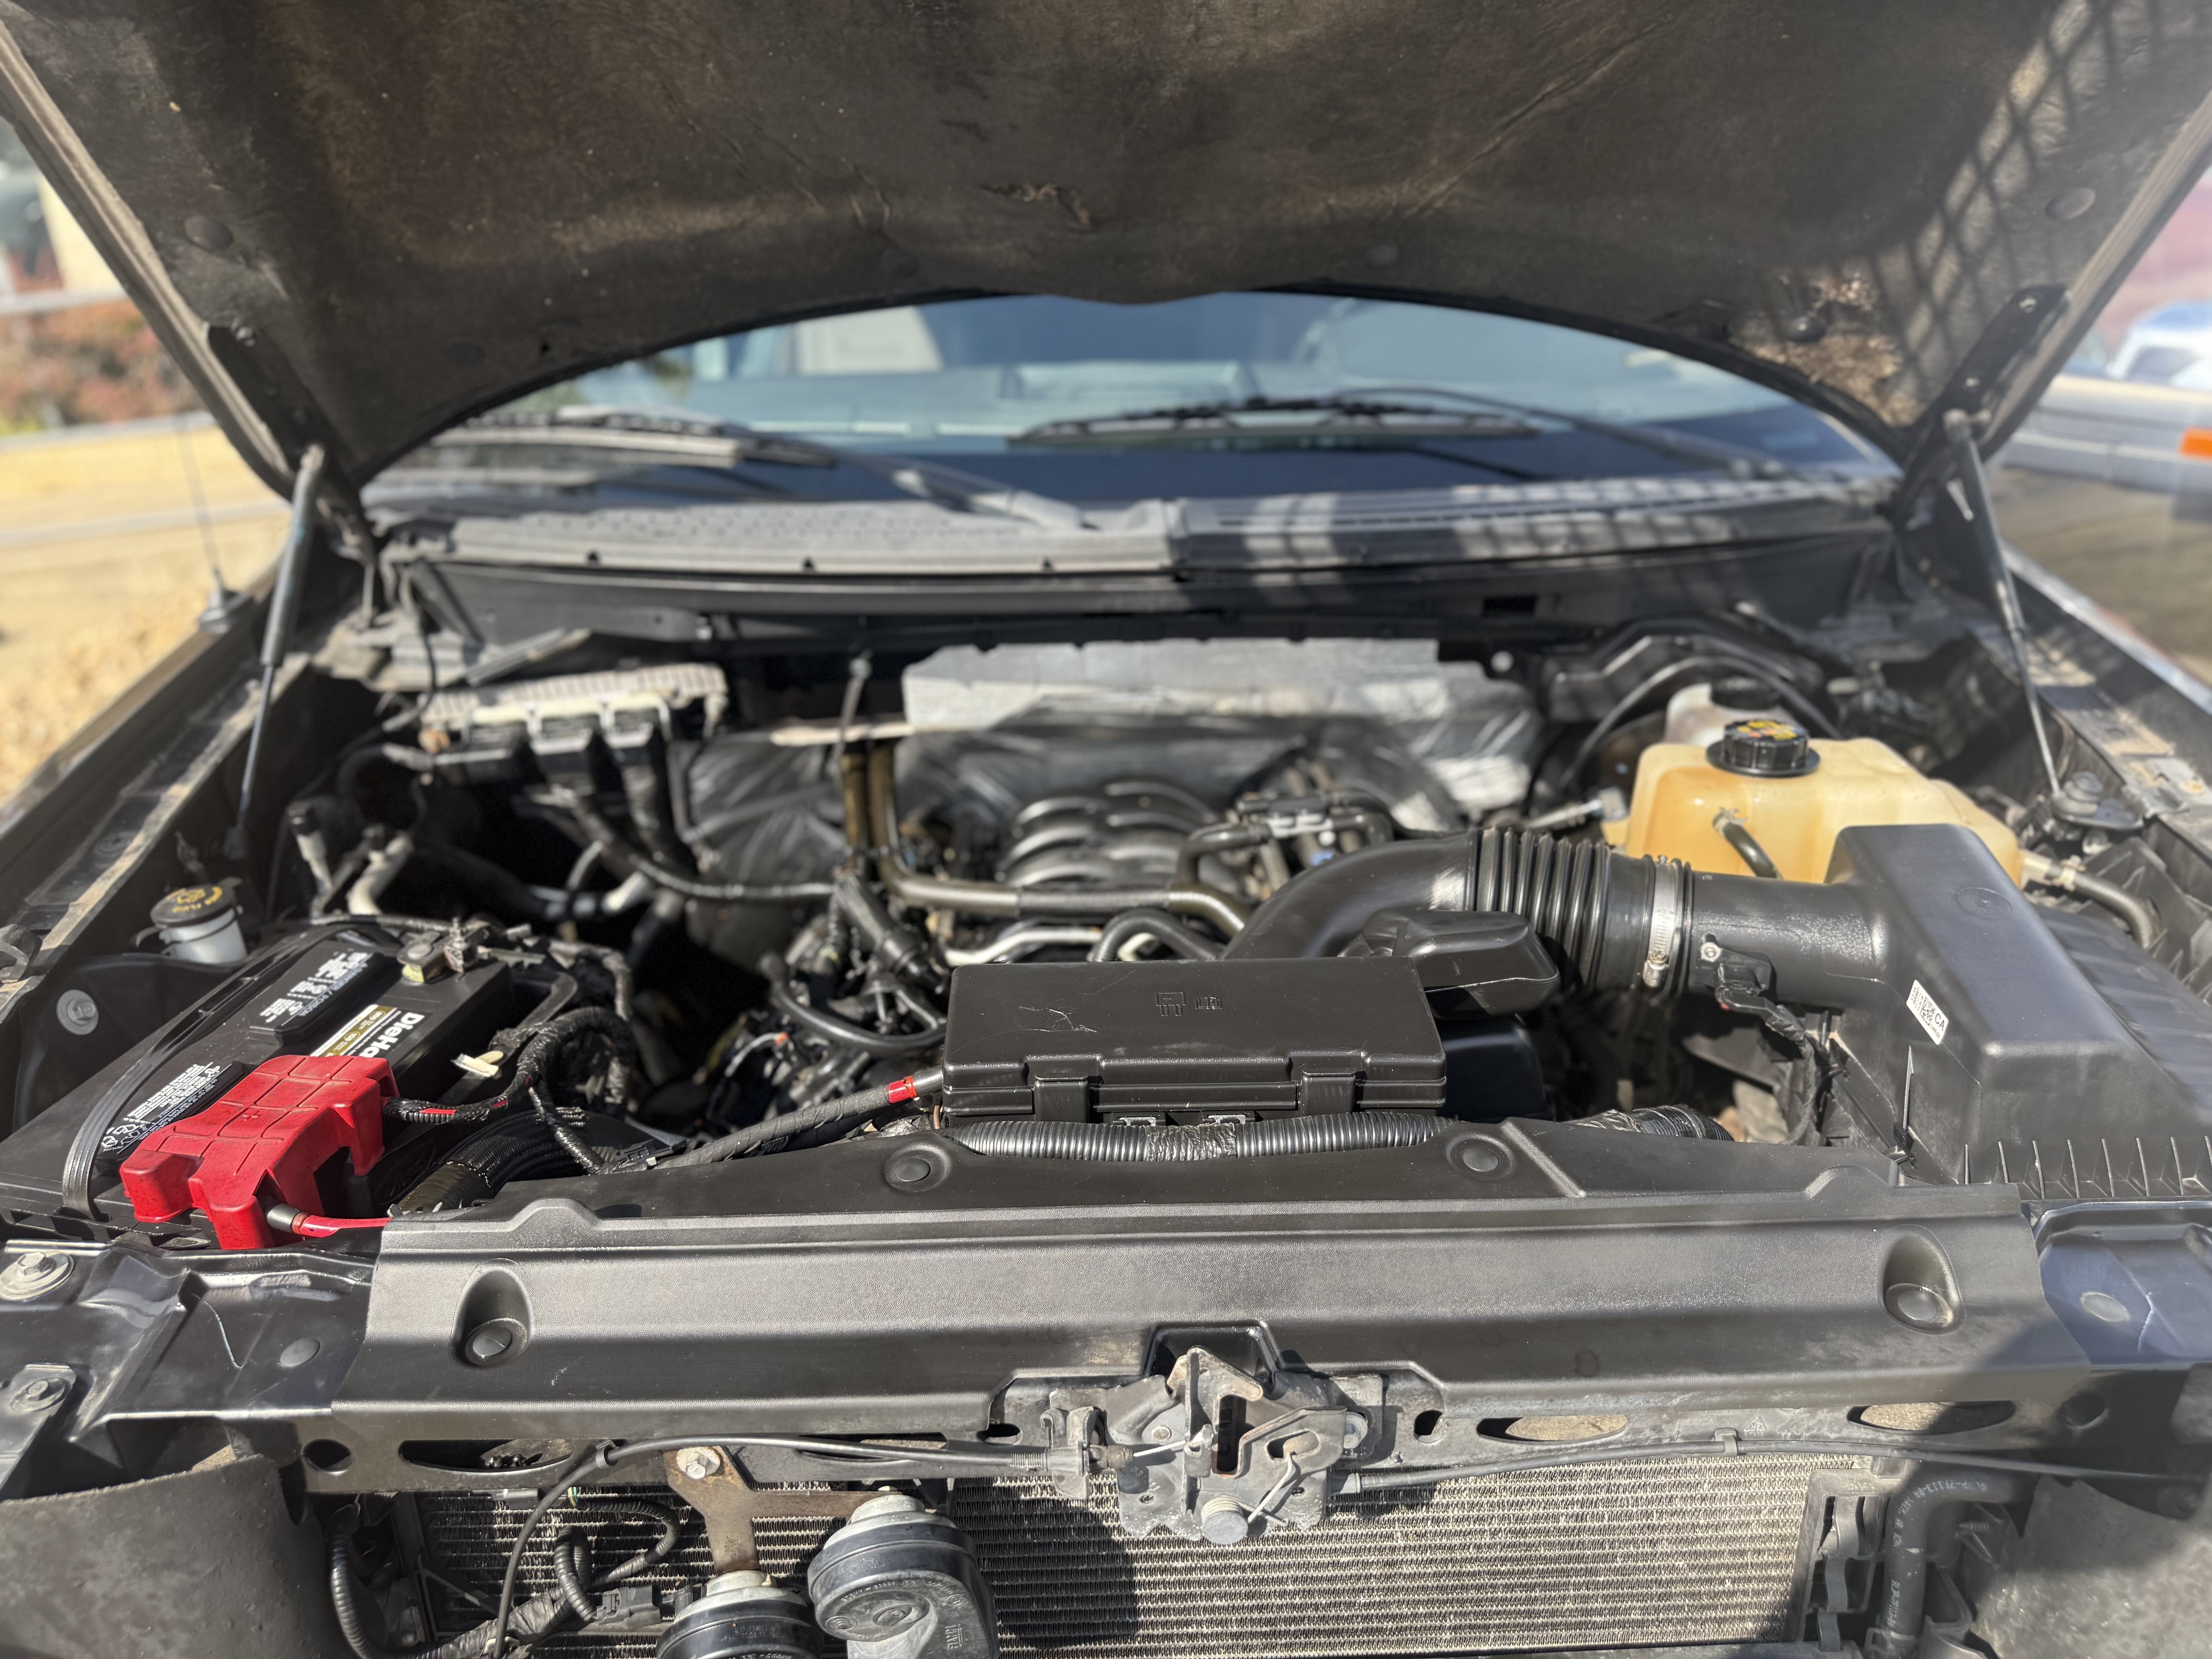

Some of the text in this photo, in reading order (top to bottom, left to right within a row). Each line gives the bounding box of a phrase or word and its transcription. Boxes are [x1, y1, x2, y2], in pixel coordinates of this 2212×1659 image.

[298, 994, 329, 1016] POISON
[1930, 1024, 1941, 1039] LINE02
[1935, 1013, 1945, 1031] CA
[359, 1012, 425, 1058] DieHa
